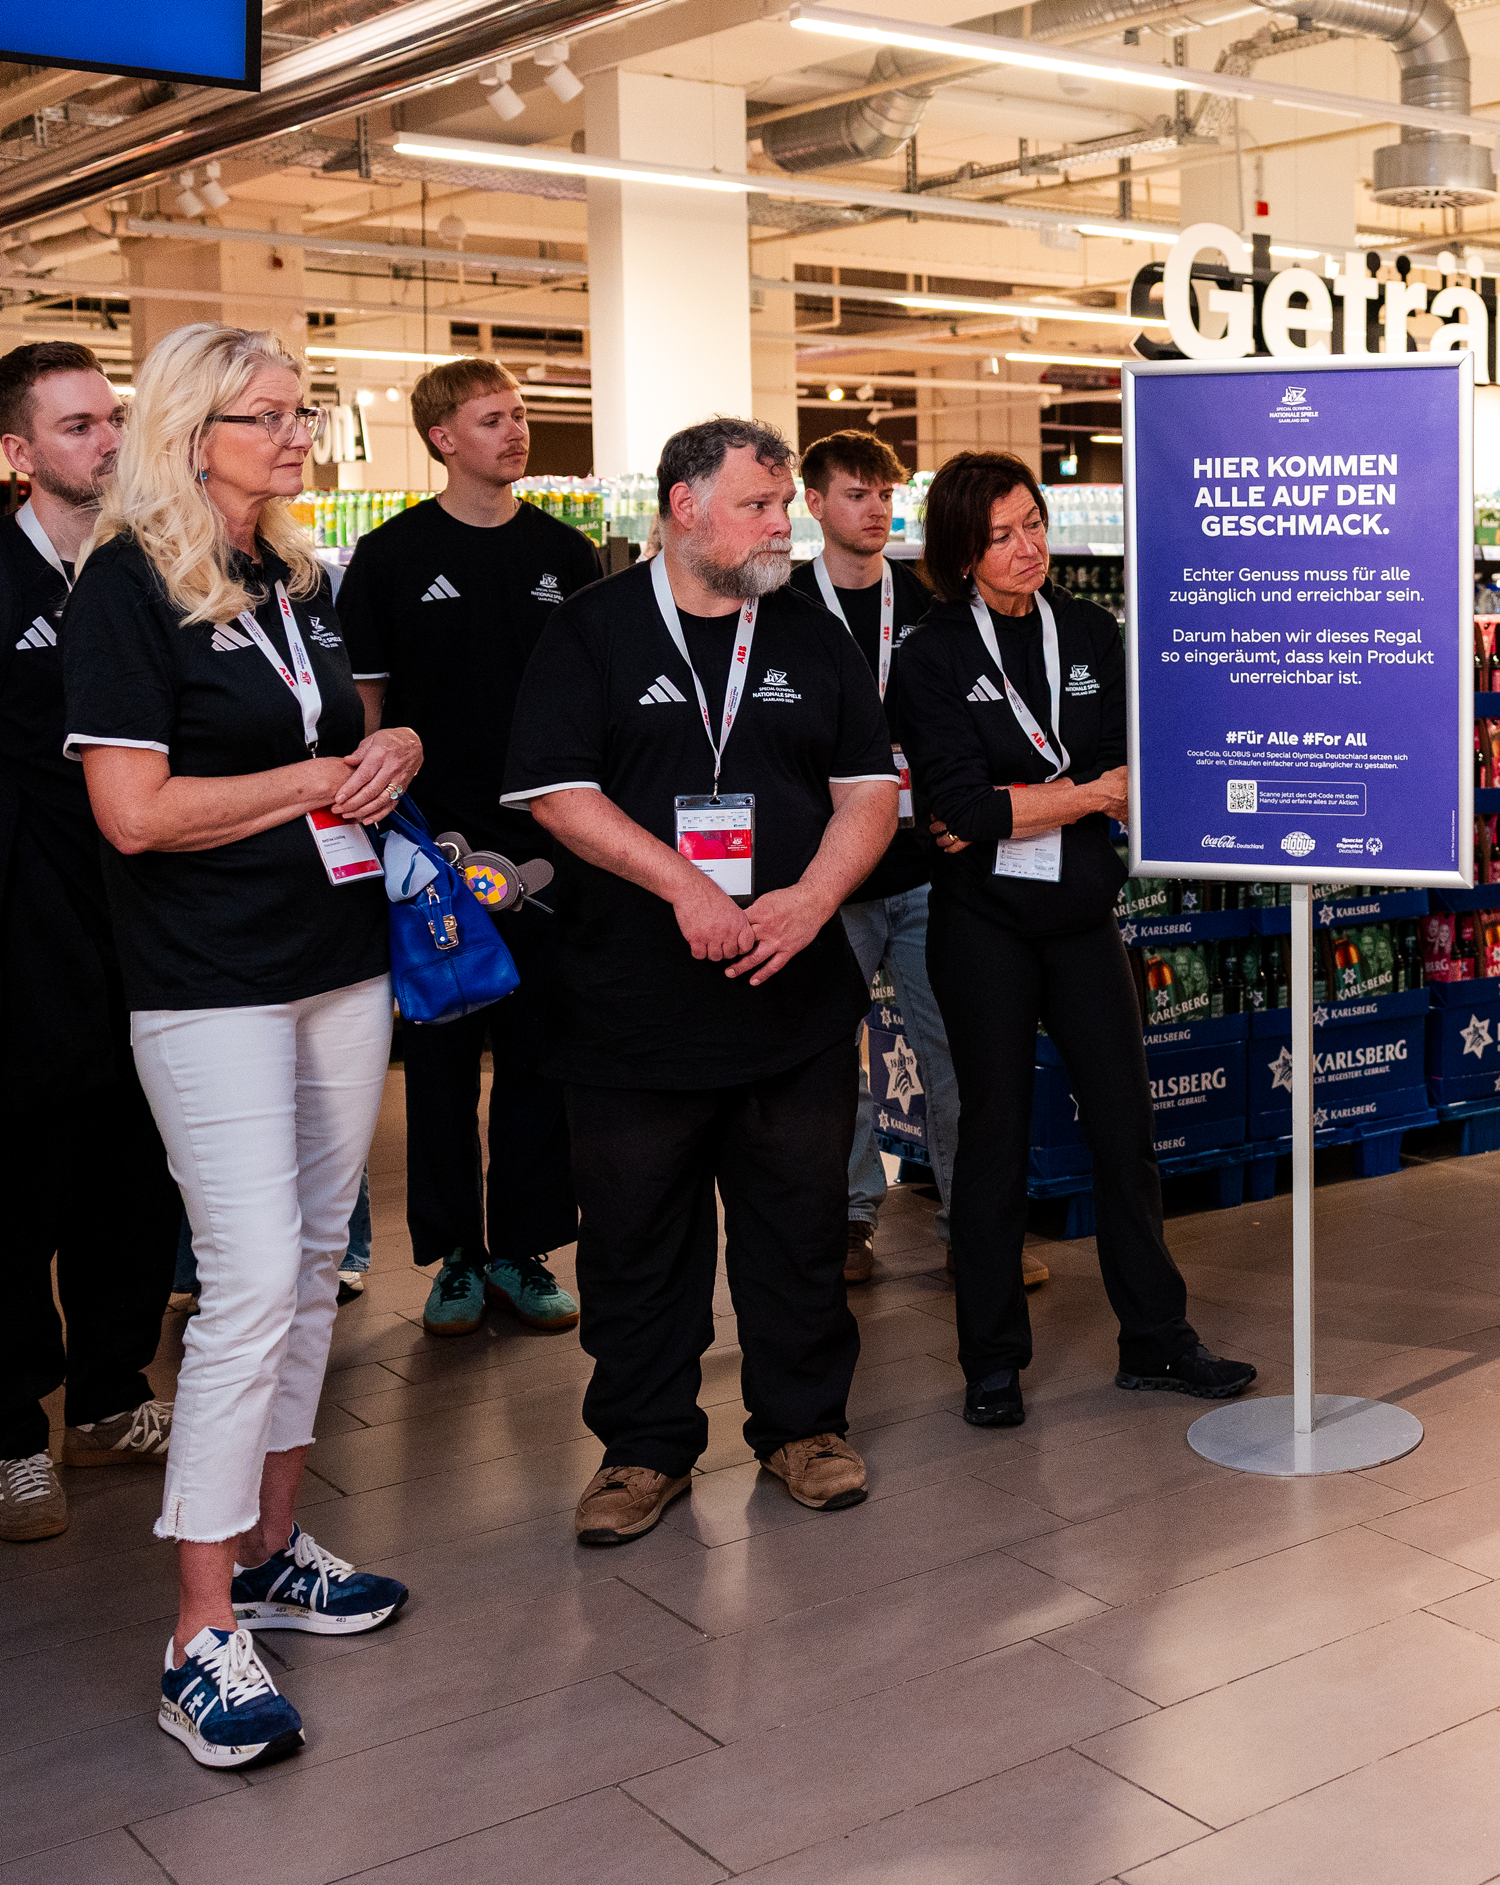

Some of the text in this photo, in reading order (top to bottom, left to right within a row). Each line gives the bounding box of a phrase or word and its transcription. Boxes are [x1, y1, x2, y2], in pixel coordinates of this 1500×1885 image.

[1194, 454, 1397, 478] HIER KOMMEN
[1195, 484, 1395, 507] ALLE AUF DEN
[1202, 514, 1389, 536] GESCHMACK.
[1184, 567, 1410, 581] Echter Genuss muss für alle
[1170, 588, 1424, 604] zugänglich und erreichbar sein.
[280, 598, 291, 618] ABB
[1174, 629, 1422, 646] Darum haben wir dieses Regal
[737, 645, 746, 664] ABB
[1162, 649, 1434, 665] so eingeräumt, dass kein Produkt
[279, 667, 295, 687] ABB
[1231, 670, 1361, 684] unerreichbar ist.
[1032, 732, 1045, 748] ABB
[1226, 731, 1367, 746] #Für Alle #For All
[1201, 834, 1237, 848] Coca-Cola
[1337, 903, 1380, 917] KARLSBERG
[1141, 923, 1192, 936] KARLSBERG
[1337, 971, 1393, 1000] KARLSBERG
[1148, 993, 1209, 1025] KARLSBERG
[1331, 1004, 1378, 1018] KARLSBERG
[1313, 1040, 1408, 1074] KARLSBERG
